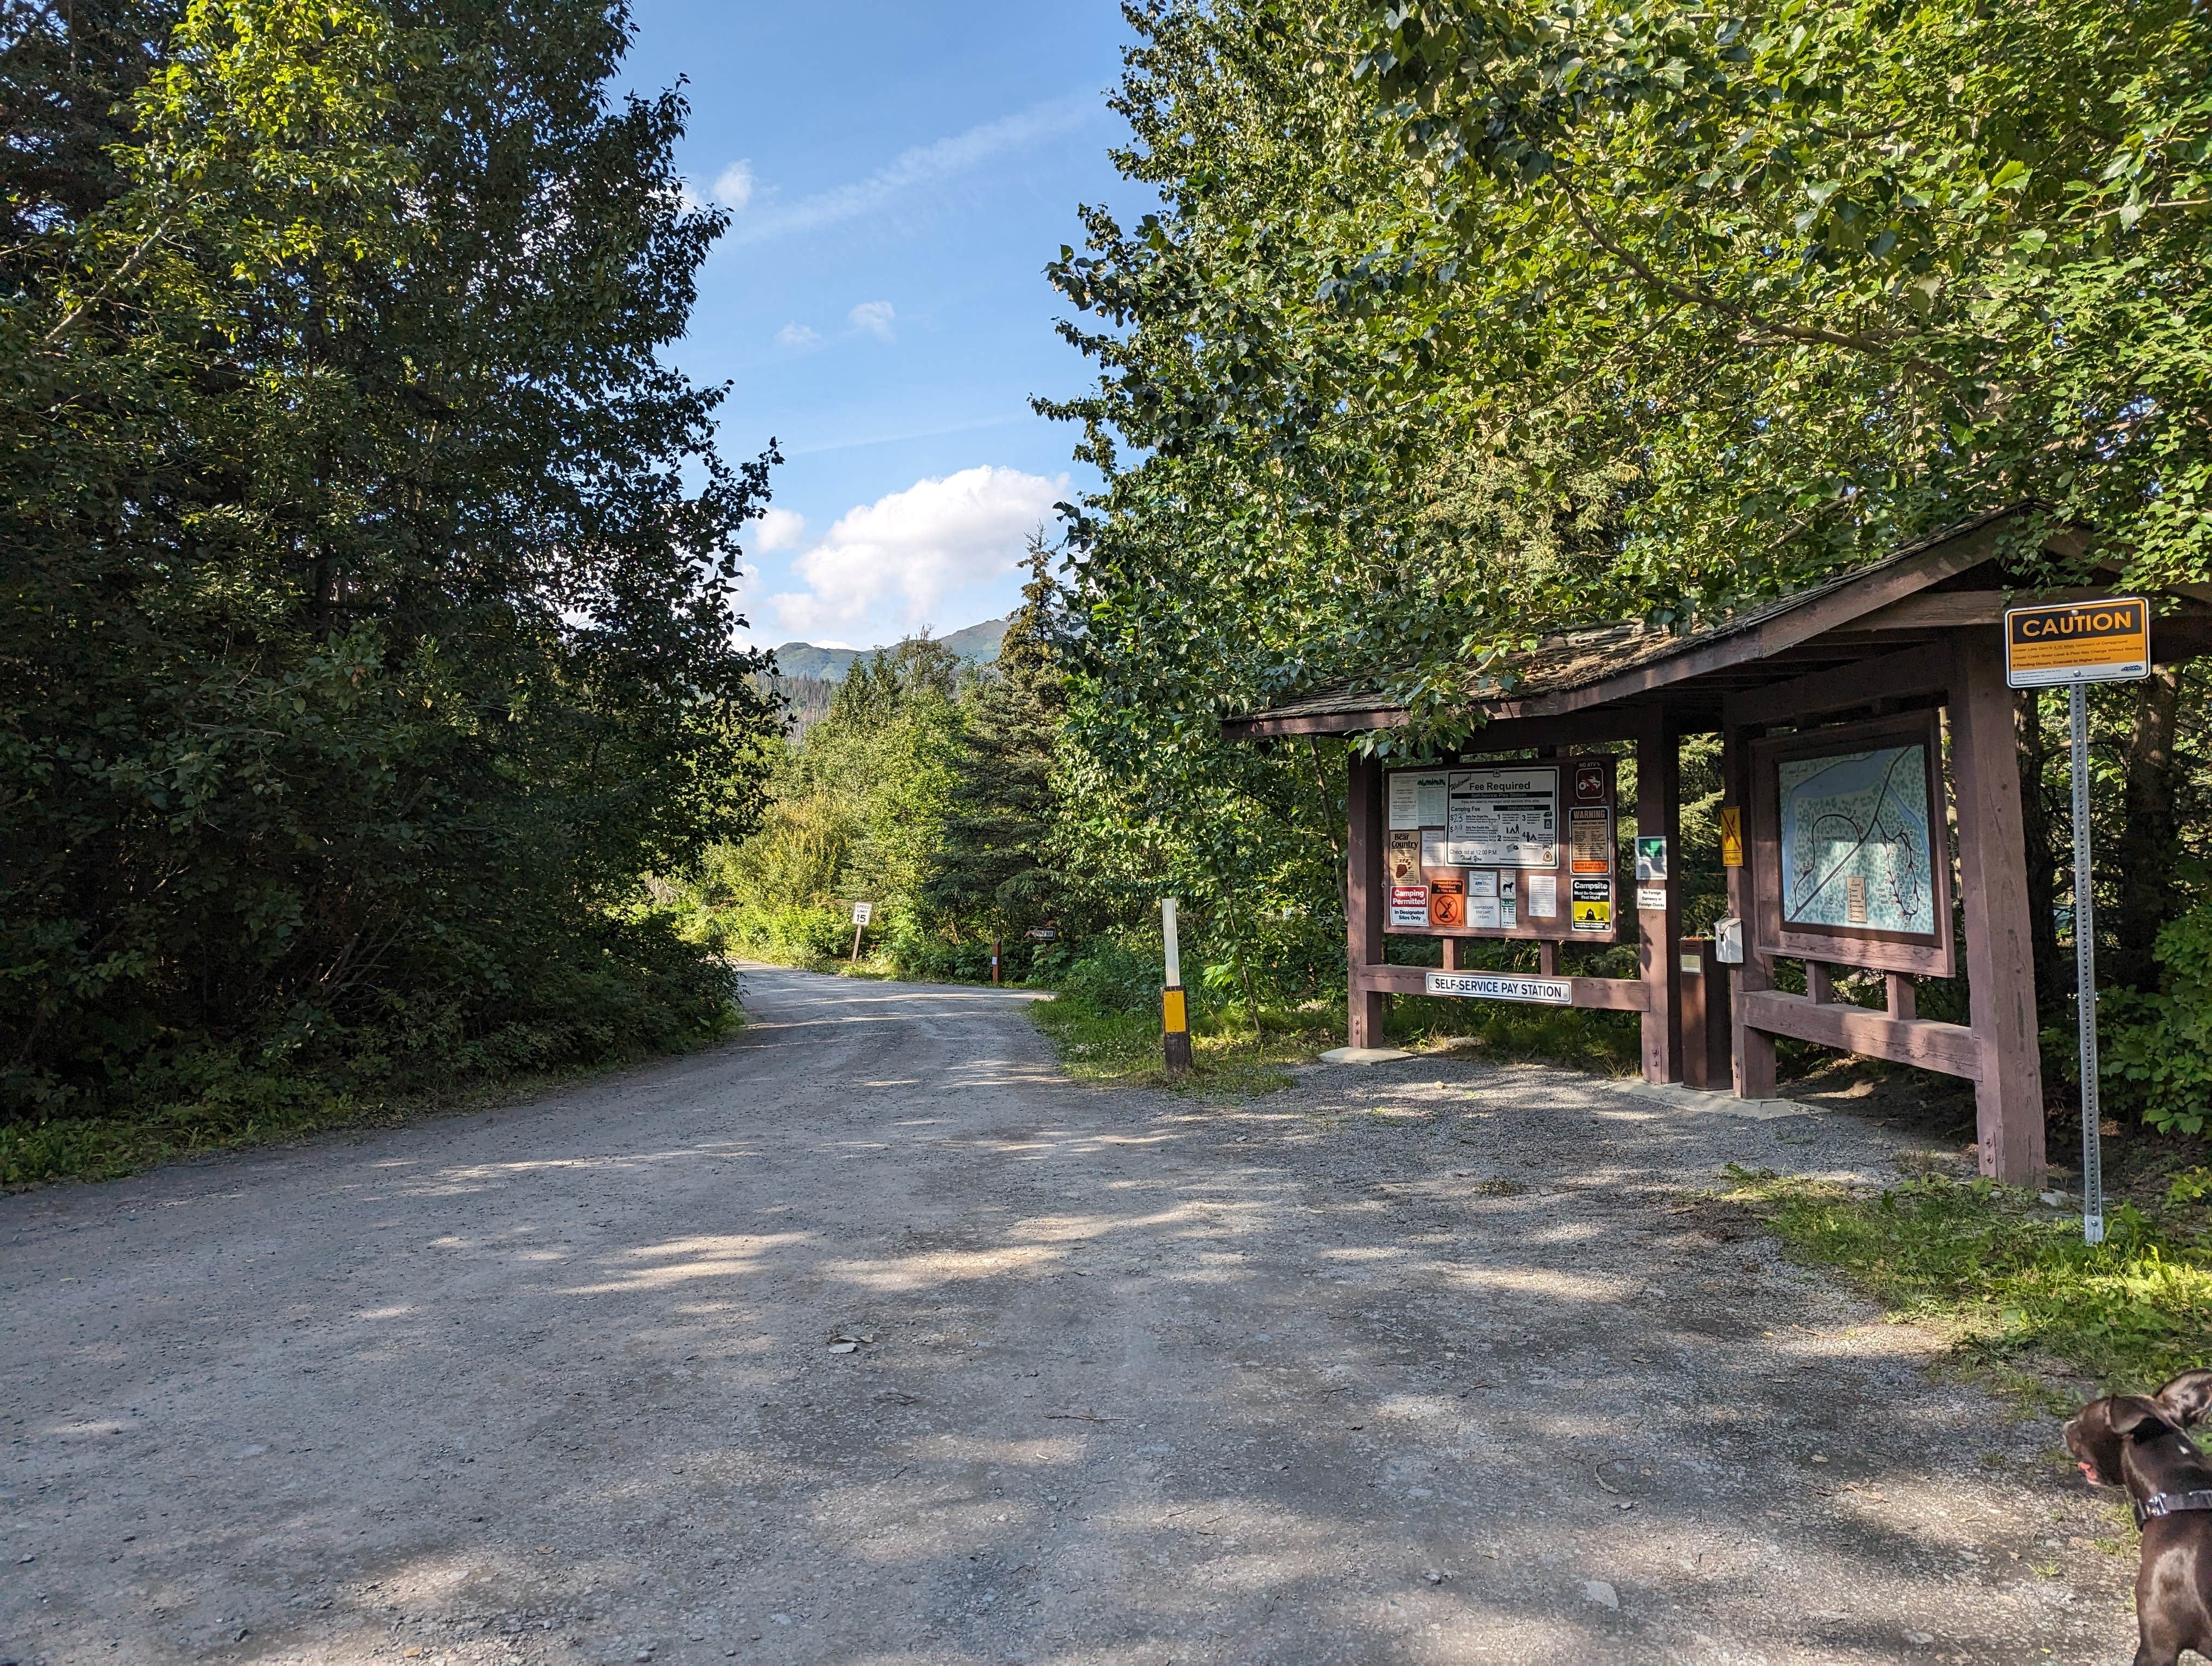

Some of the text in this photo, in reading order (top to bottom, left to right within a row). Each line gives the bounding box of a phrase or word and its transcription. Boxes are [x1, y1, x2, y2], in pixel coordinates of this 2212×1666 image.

[2022, 611, 2131, 637] CAUTION
[1469, 781, 1531, 792] Fee Required
[1573, 810, 1605, 819] WARNING
[1391, 841, 1418, 850] Country
[1574, 882, 1608, 890] Campsite
[1394, 889, 1424, 898] Camping
[857, 914, 866, 923] 15
[1435, 978, 1561, 998] SELF-SERVICE PAY STATION
